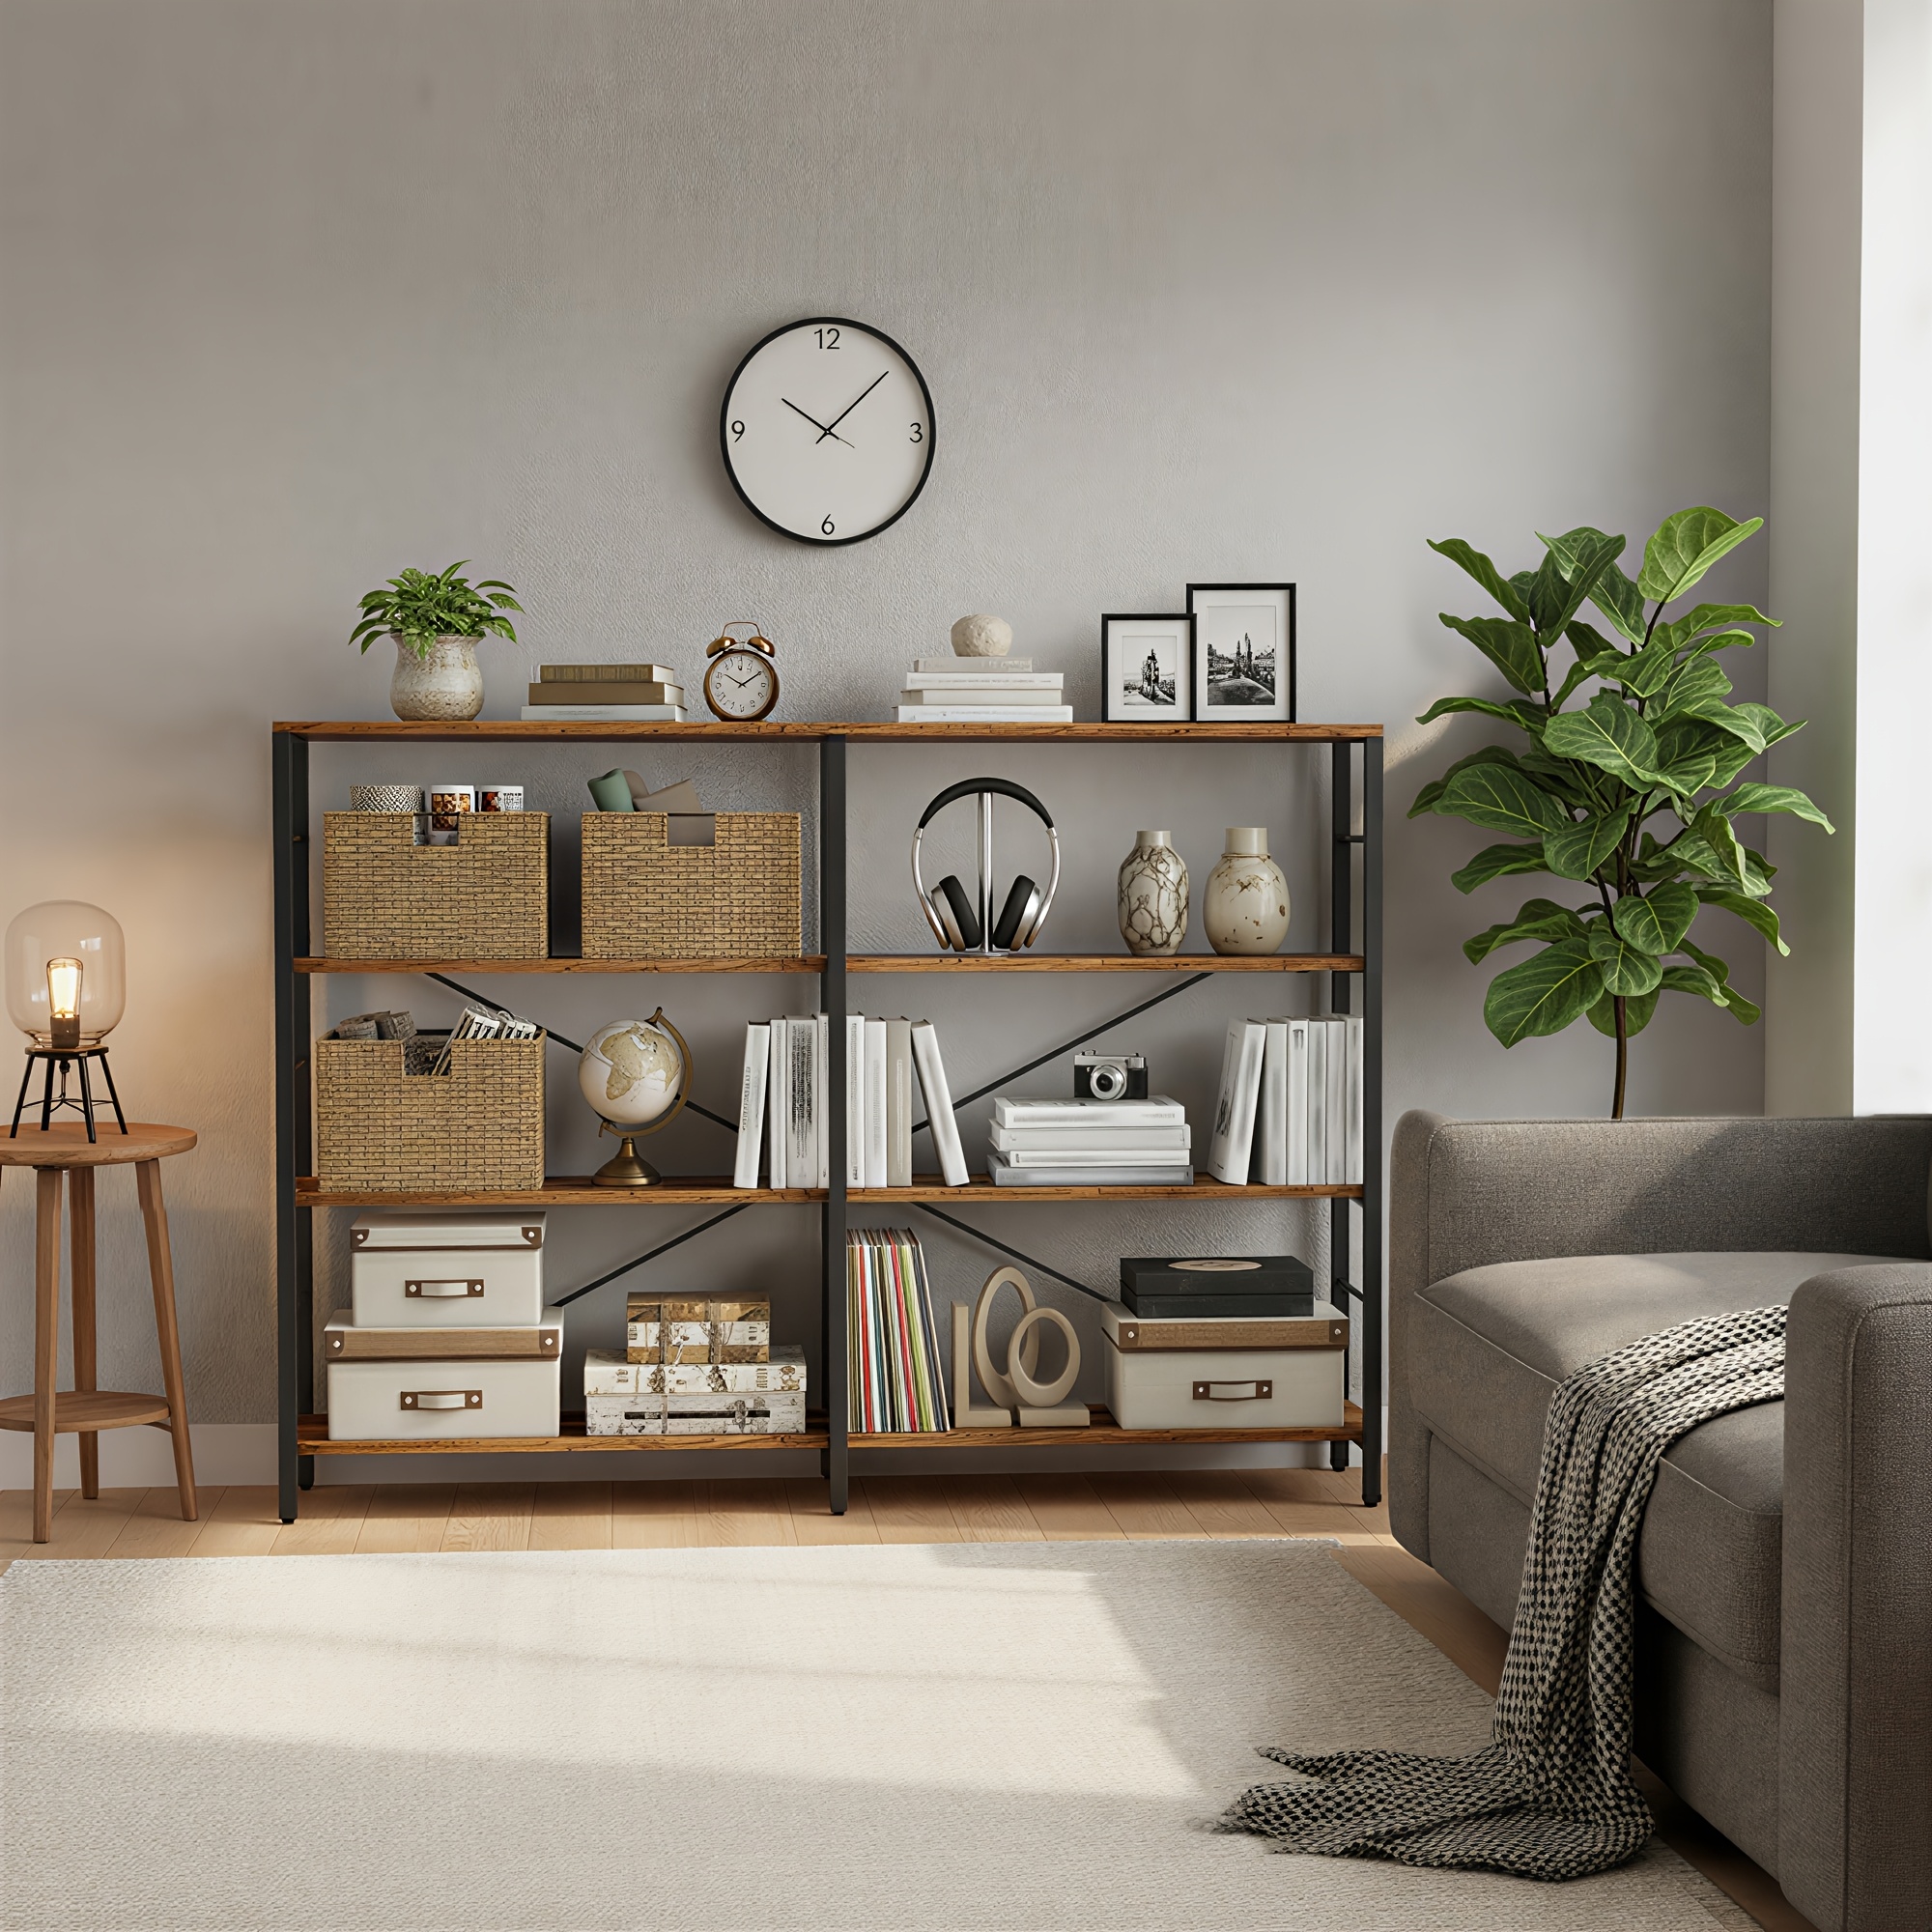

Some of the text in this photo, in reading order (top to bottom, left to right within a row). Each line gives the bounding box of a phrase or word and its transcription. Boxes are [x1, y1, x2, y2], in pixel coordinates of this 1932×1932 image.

[813, 328, 840, 350] 12
[731, 420, 746, 443] 9
[909, 422, 923, 443] 3
[821, 514, 836, 535] 6
